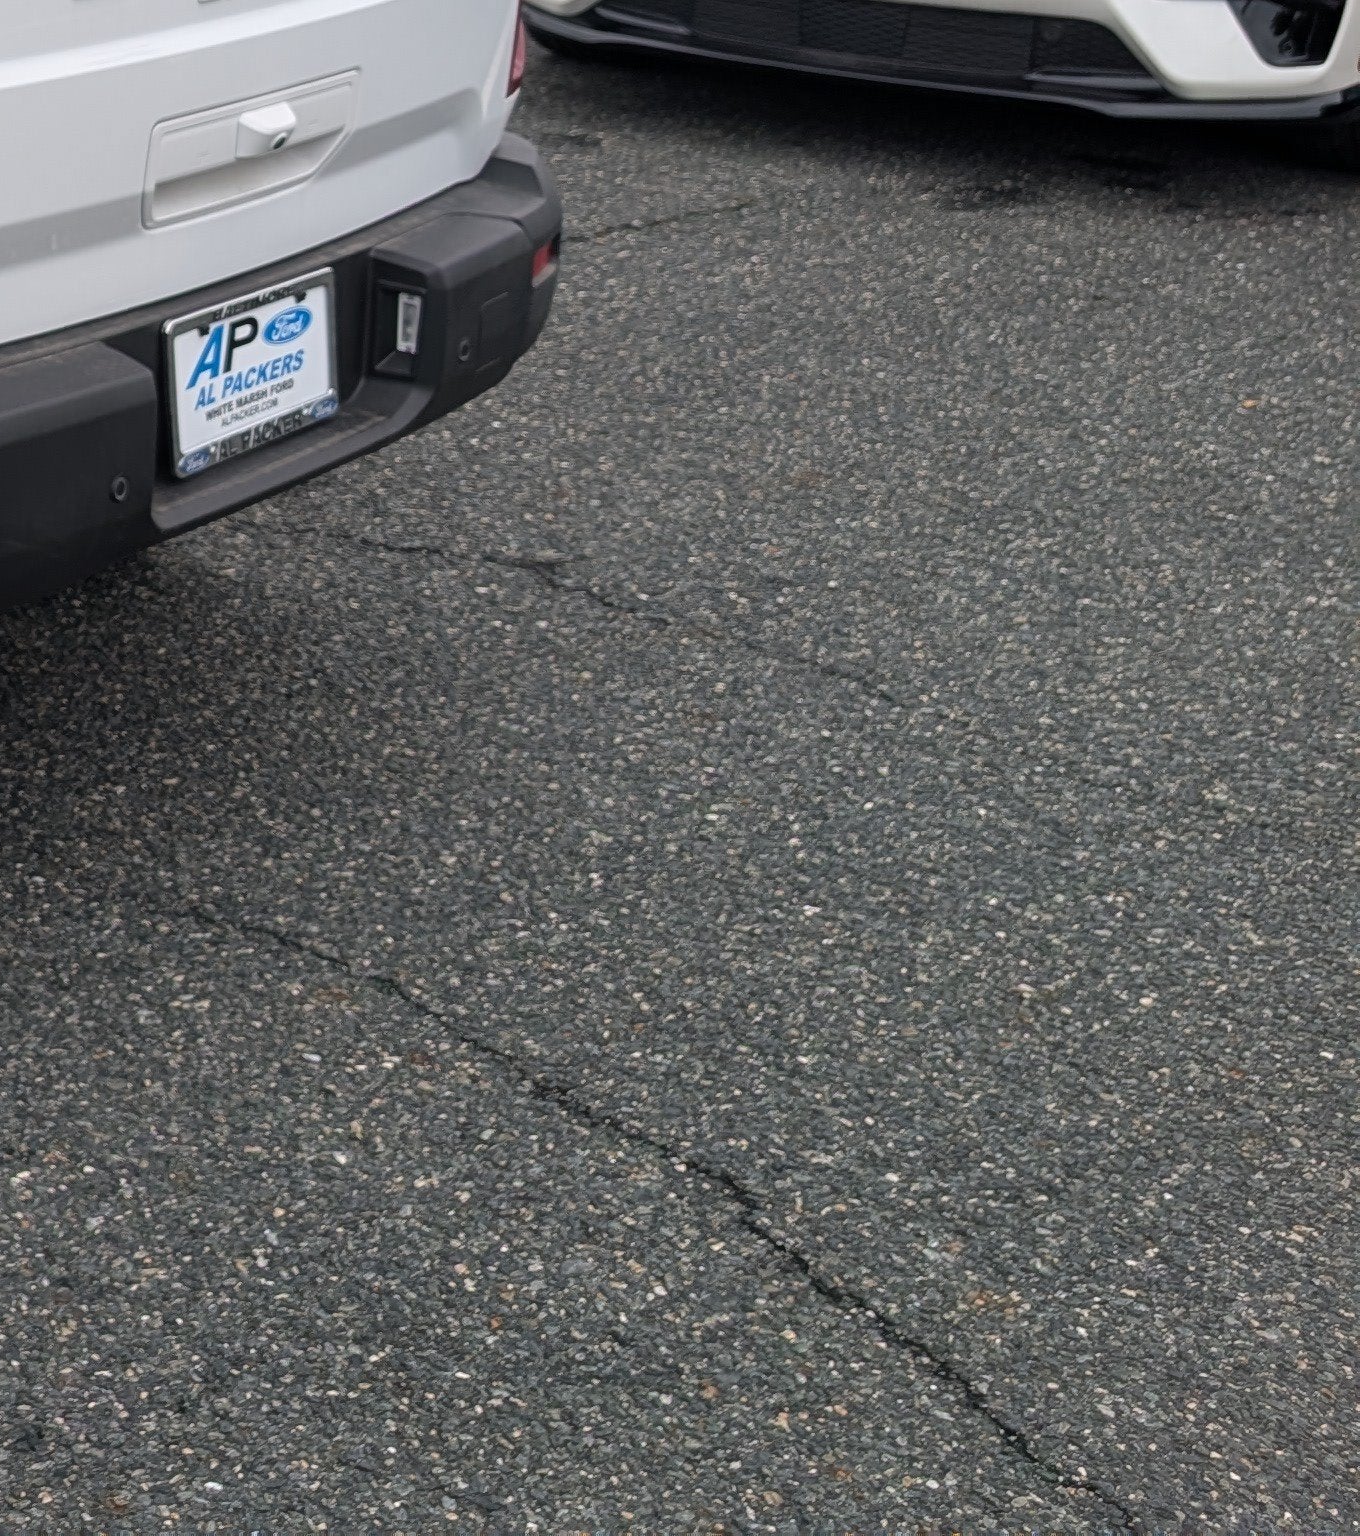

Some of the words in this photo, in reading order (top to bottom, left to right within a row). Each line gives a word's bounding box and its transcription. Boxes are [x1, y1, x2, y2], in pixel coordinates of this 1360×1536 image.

[185, 317, 258, 390] AP
[194, 386, 216, 410] AL
[222, 348, 305, 399] PACKERS
[205, 400, 233, 421] WHITE
[270, 377, 295, 396] FORD
